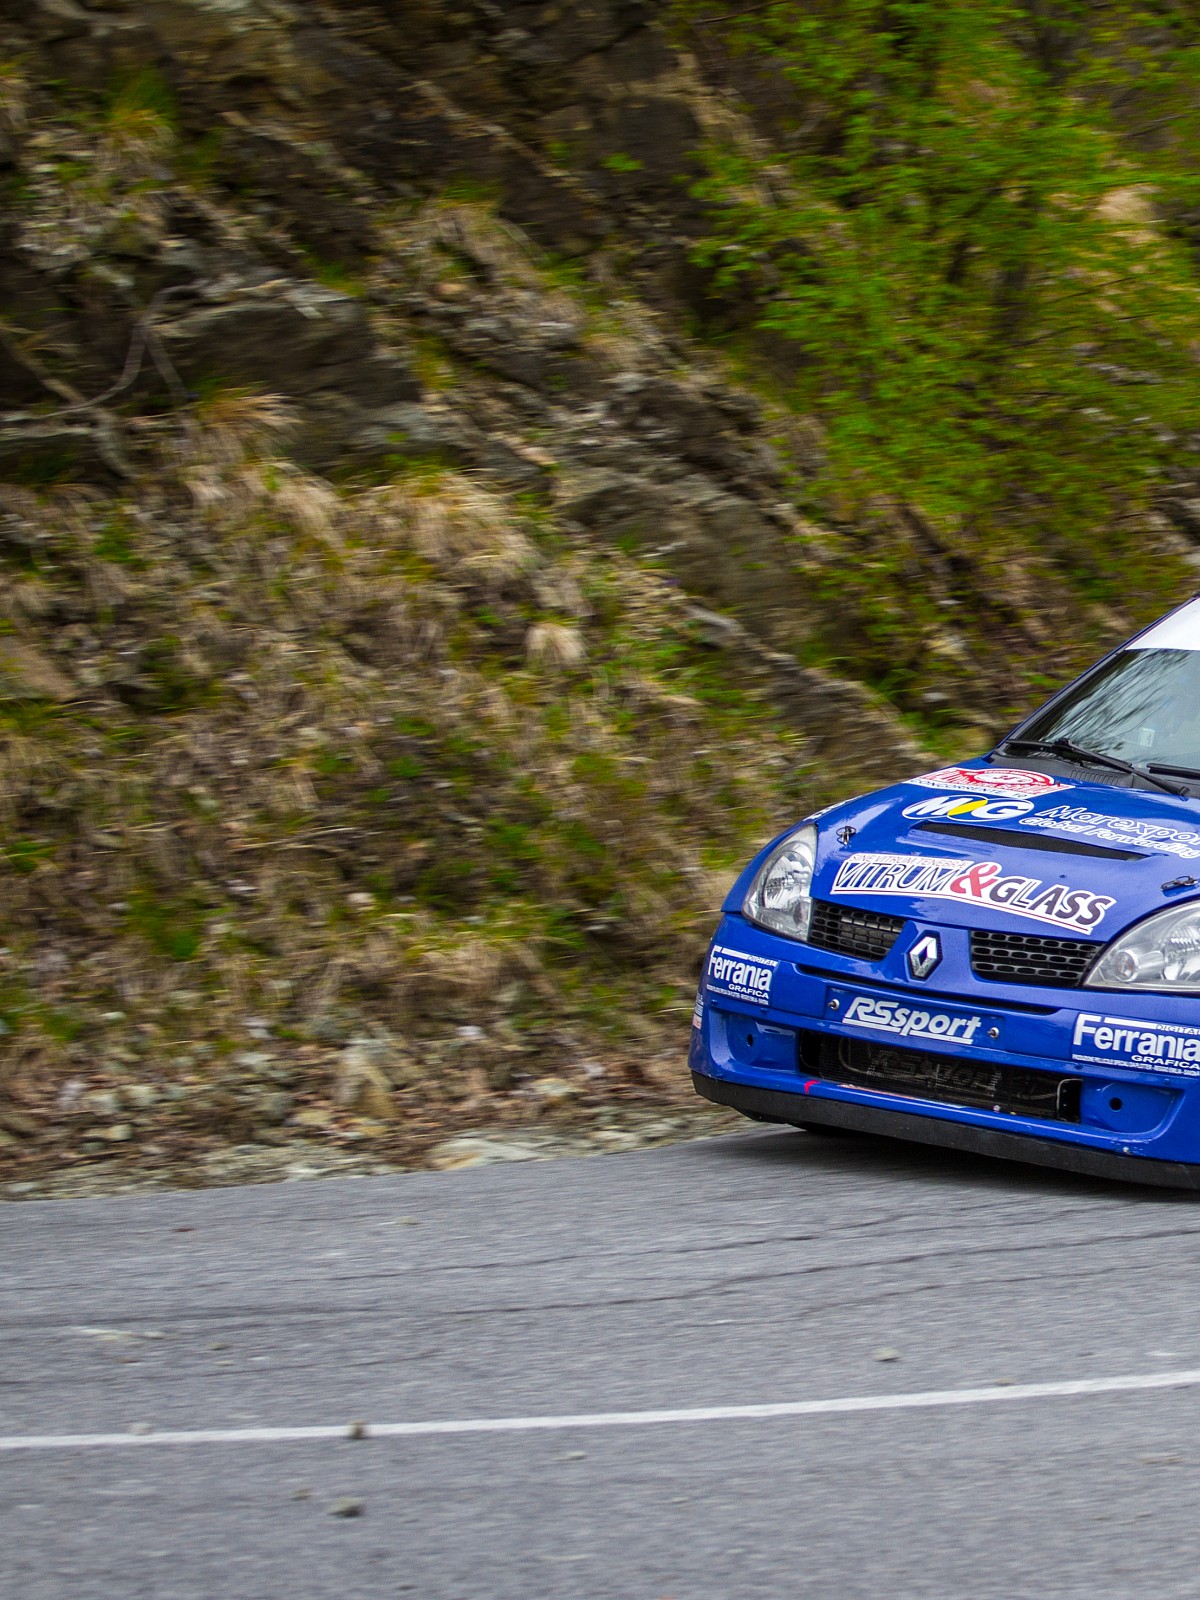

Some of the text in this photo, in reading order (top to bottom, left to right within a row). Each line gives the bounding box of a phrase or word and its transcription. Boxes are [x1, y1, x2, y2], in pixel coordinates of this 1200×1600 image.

[1018, 815, 1091, 835] Global
[708, 944, 773, 992] Ferrania
[728, 983, 770, 999] GRAFICA
[1130, 1055, 1200, 1070] GRAFICA
